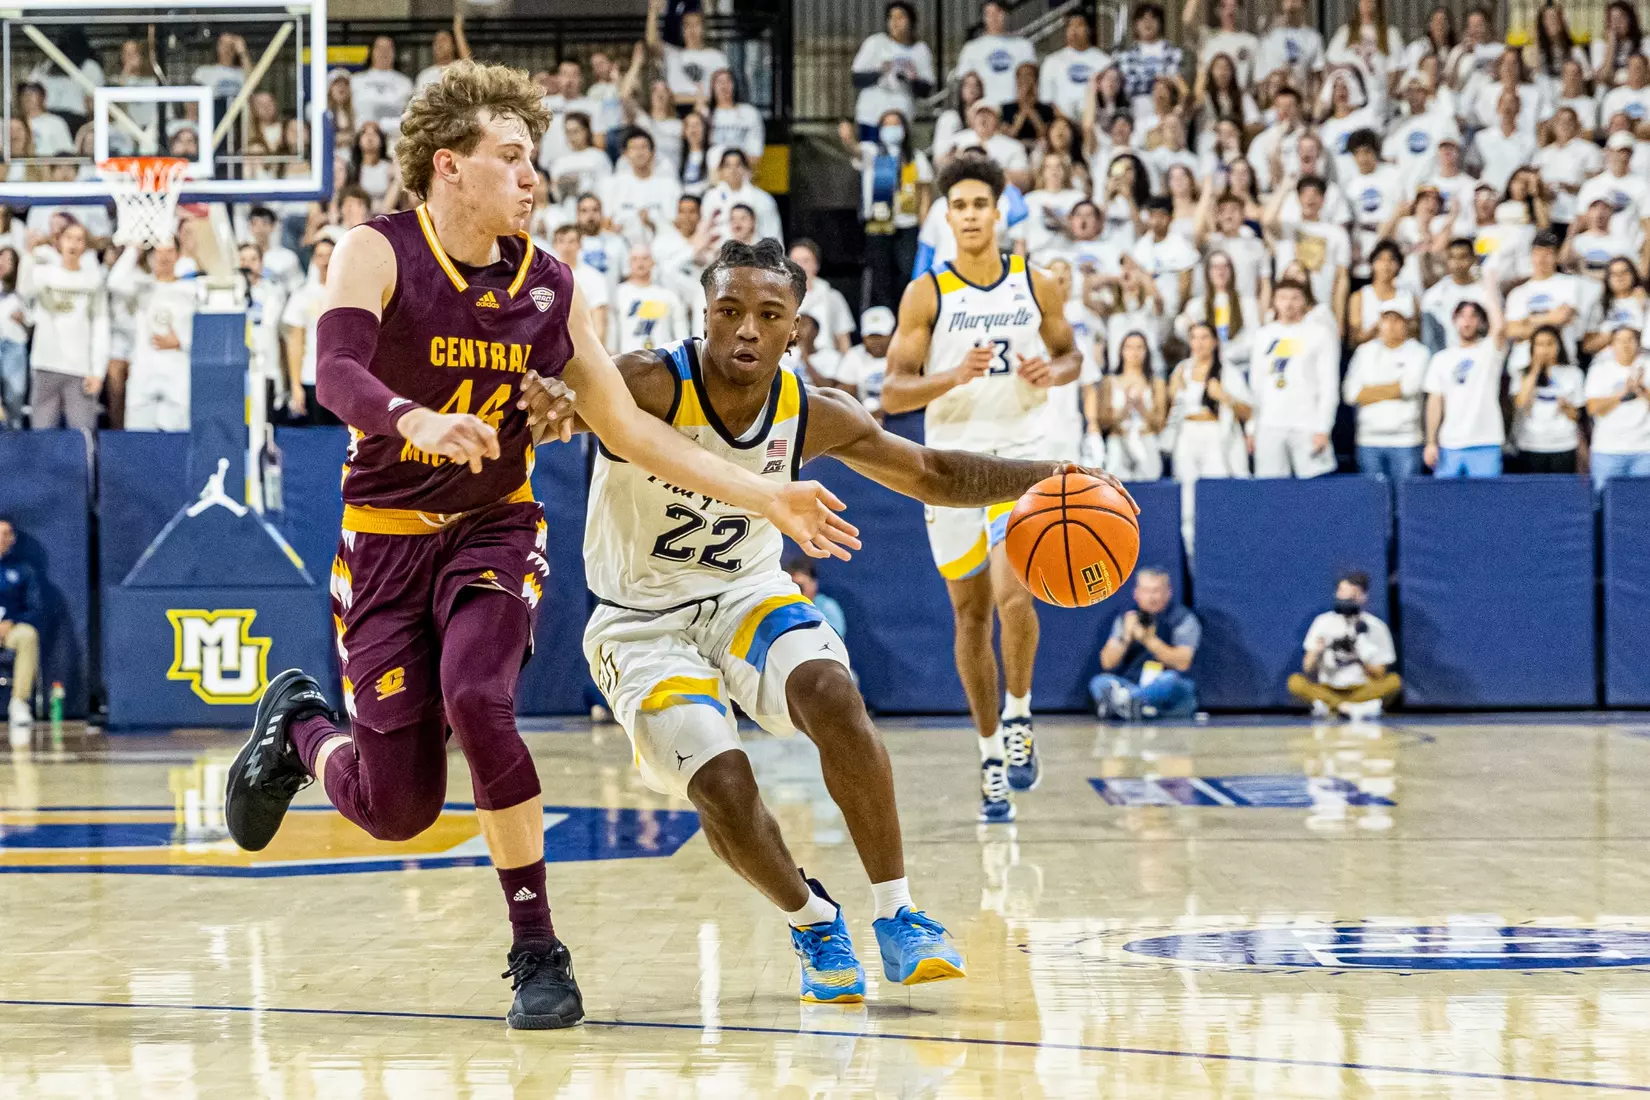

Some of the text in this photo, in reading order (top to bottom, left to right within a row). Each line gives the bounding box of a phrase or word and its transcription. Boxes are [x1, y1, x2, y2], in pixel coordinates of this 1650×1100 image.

[475, 301, 499, 309] adidas
[948, 307, 1034, 333] Marquette
[430, 336, 532, 374] CENTRAL
[650, 502, 751, 574] 22
[171, 611, 269, 701] MU
